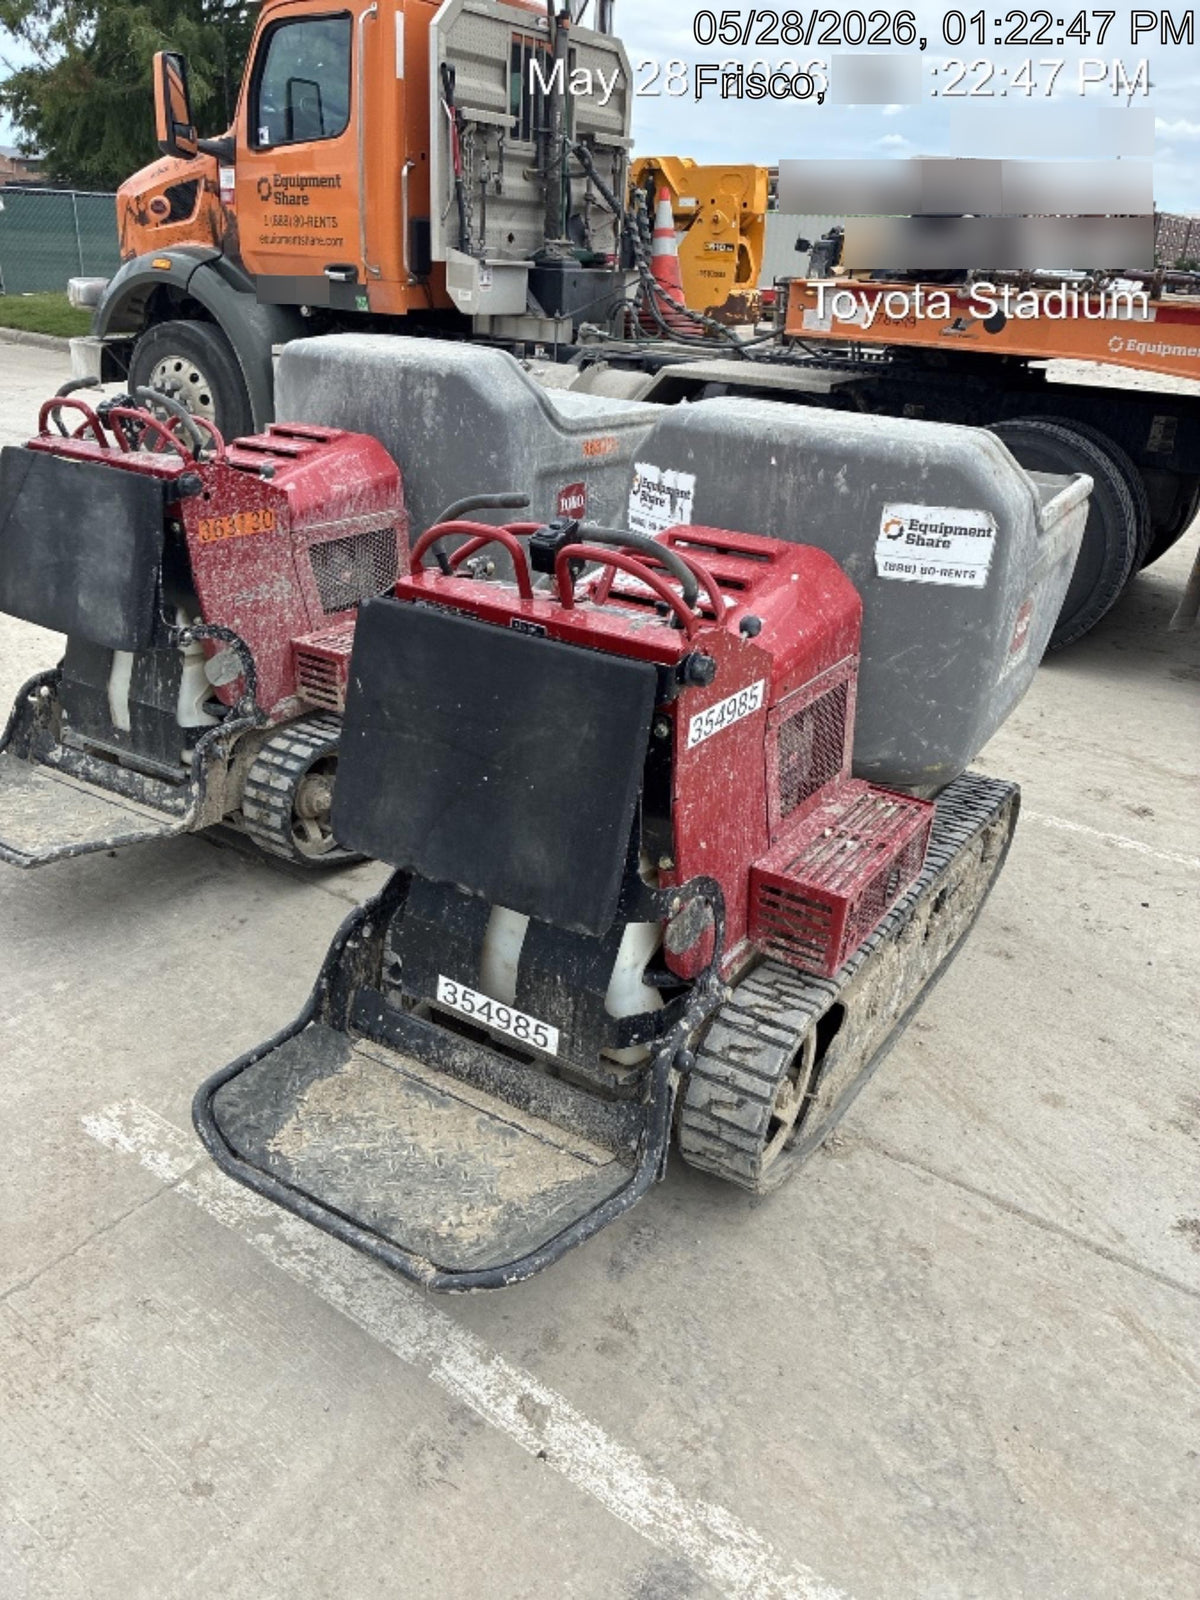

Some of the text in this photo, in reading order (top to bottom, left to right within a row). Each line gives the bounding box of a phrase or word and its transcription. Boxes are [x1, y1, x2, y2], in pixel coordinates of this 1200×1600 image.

[273, 174, 342, 191] Equipment
[273, 191, 310, 206] Share
[907, 518, 993, 538] Equipment
[905, 533, 951, 549] Share
[691, 685, 758, 744] 354985
[443, 982, 549, 1048] 354985
